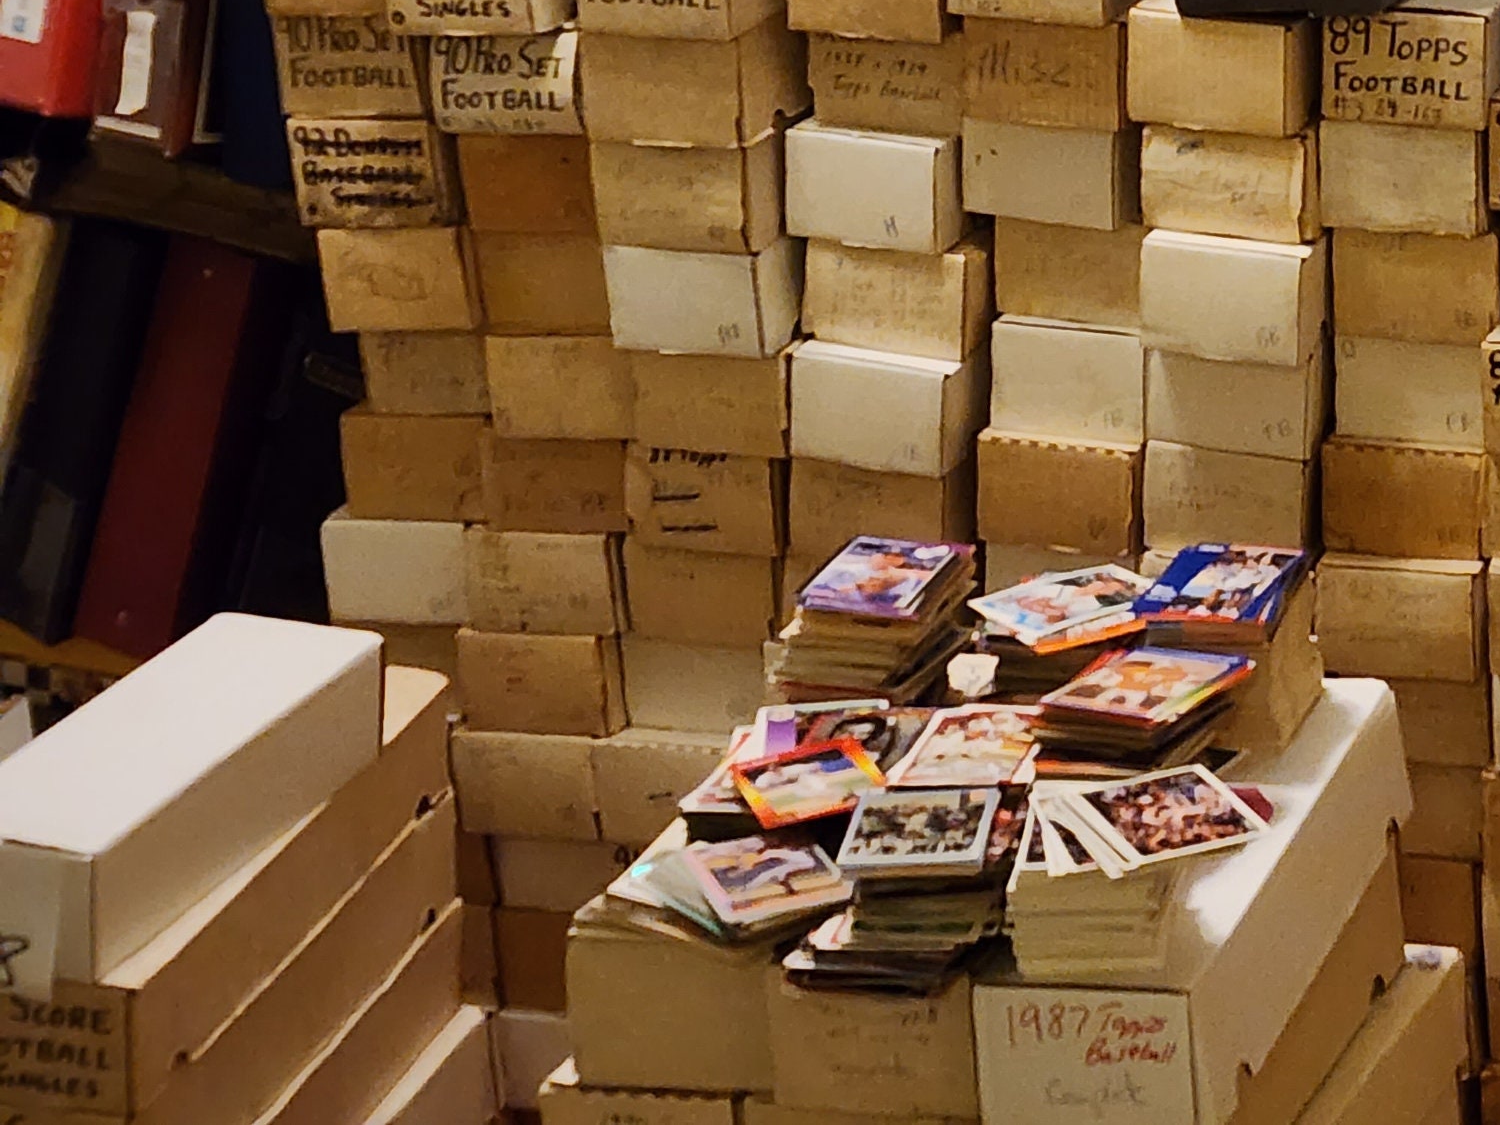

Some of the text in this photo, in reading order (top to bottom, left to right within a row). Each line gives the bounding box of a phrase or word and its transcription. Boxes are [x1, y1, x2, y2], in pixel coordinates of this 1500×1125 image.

[432, 36, 567, 81] 90 PRO SET
[1328, 15, 1469, 67] 89 TOPPS
[289, 55, 413, 89] FOOTBALL
[1333, 60, 1471, 102] FOOTBALL
[441, 79, 566, 114] FOOTBALL
[9, 994, 114, 1036] SCORE
[1006, 1000, 1091, 1049] 1987
